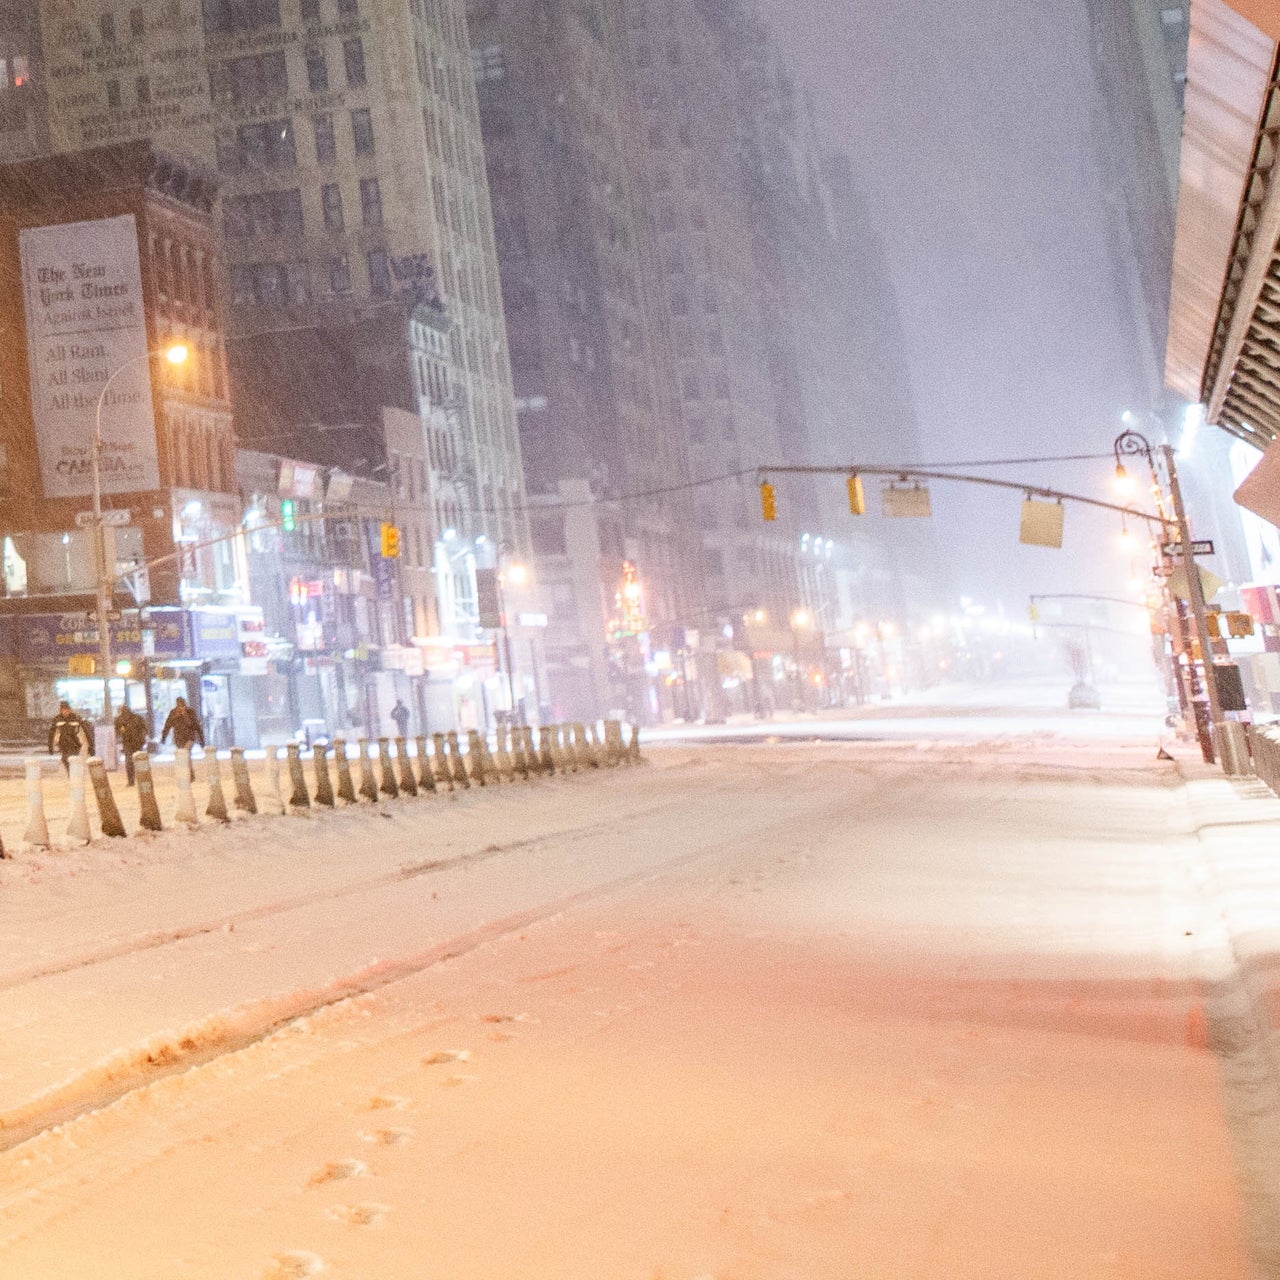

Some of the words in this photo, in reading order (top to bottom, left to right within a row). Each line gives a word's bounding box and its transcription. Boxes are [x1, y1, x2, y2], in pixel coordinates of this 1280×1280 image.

[37, 266, 66, 284] The
[71, 263, 106, 280] New
[40, 286, 75, 307] York
[80, 281, 129, 300] Times
